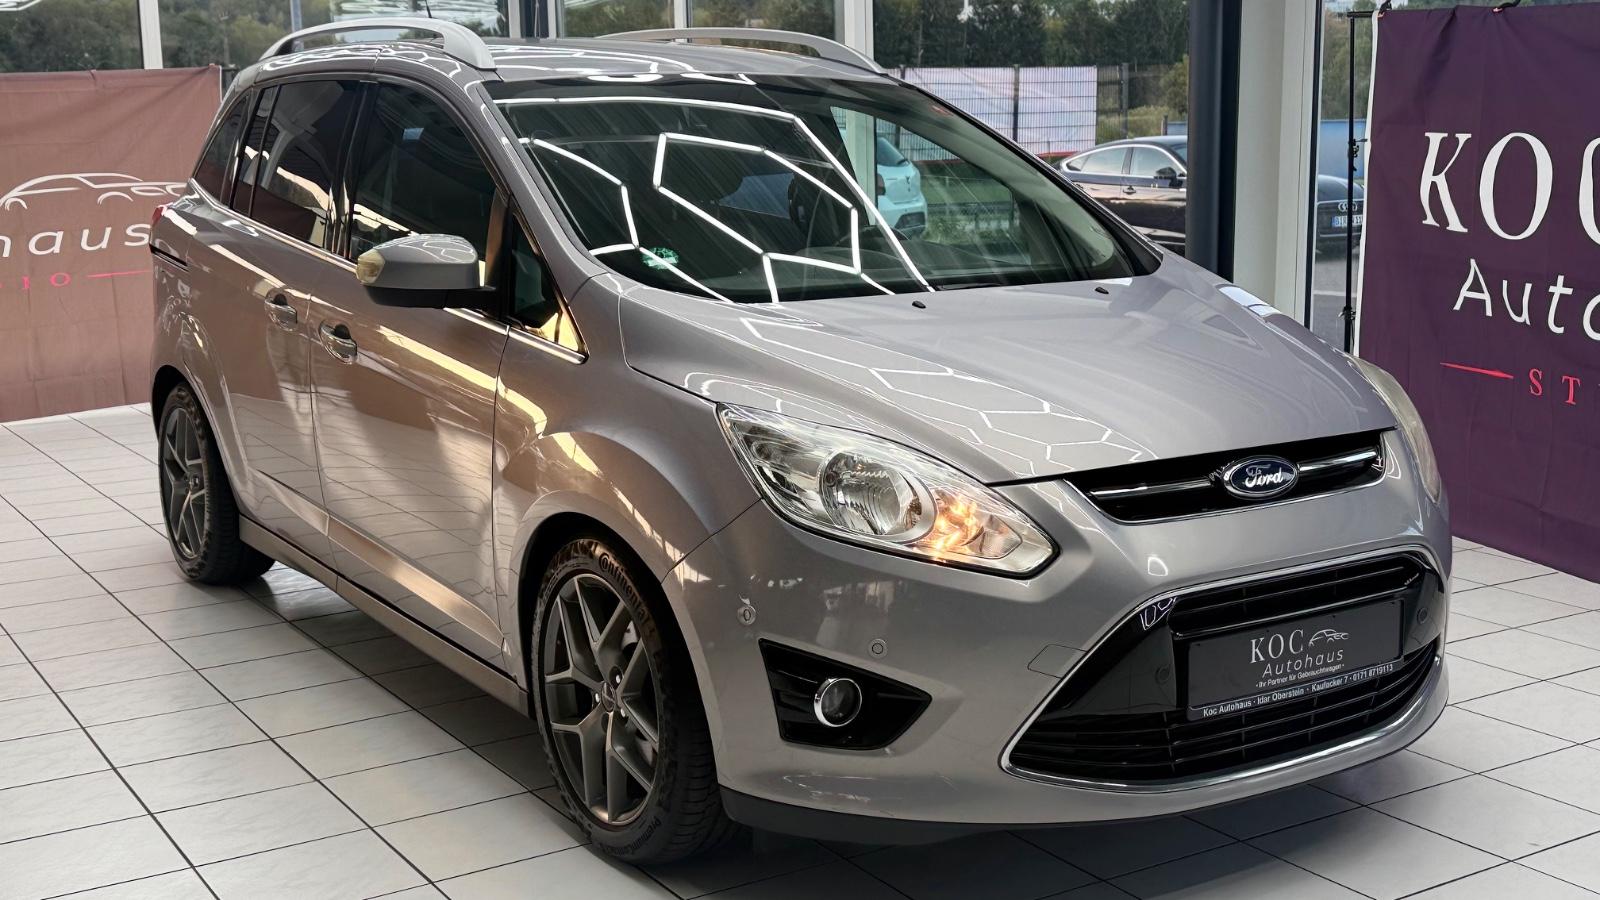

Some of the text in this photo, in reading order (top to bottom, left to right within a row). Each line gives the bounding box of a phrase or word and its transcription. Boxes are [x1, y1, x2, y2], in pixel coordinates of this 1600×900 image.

[0, 272, 72, 289] IO
[1529, 368, 1600, 405] ST
[1242, 464, 1283, 488] Ford
[599, 552, 653, 627] Continental
[1250, 629, 1304, 664] KOC
[1262, 649, 1344, 678] Autohaus
[1203, 708, 1218, 718] Koc
[1219, 700, 1252, 714] Autohaus
[1257, 695, 1271, 705] Idar
[1272, 688, 1305, 701] Oberstein
[1352, 671, 1367, 681] 0171
[1267, 676, 1287, 687] Partner
